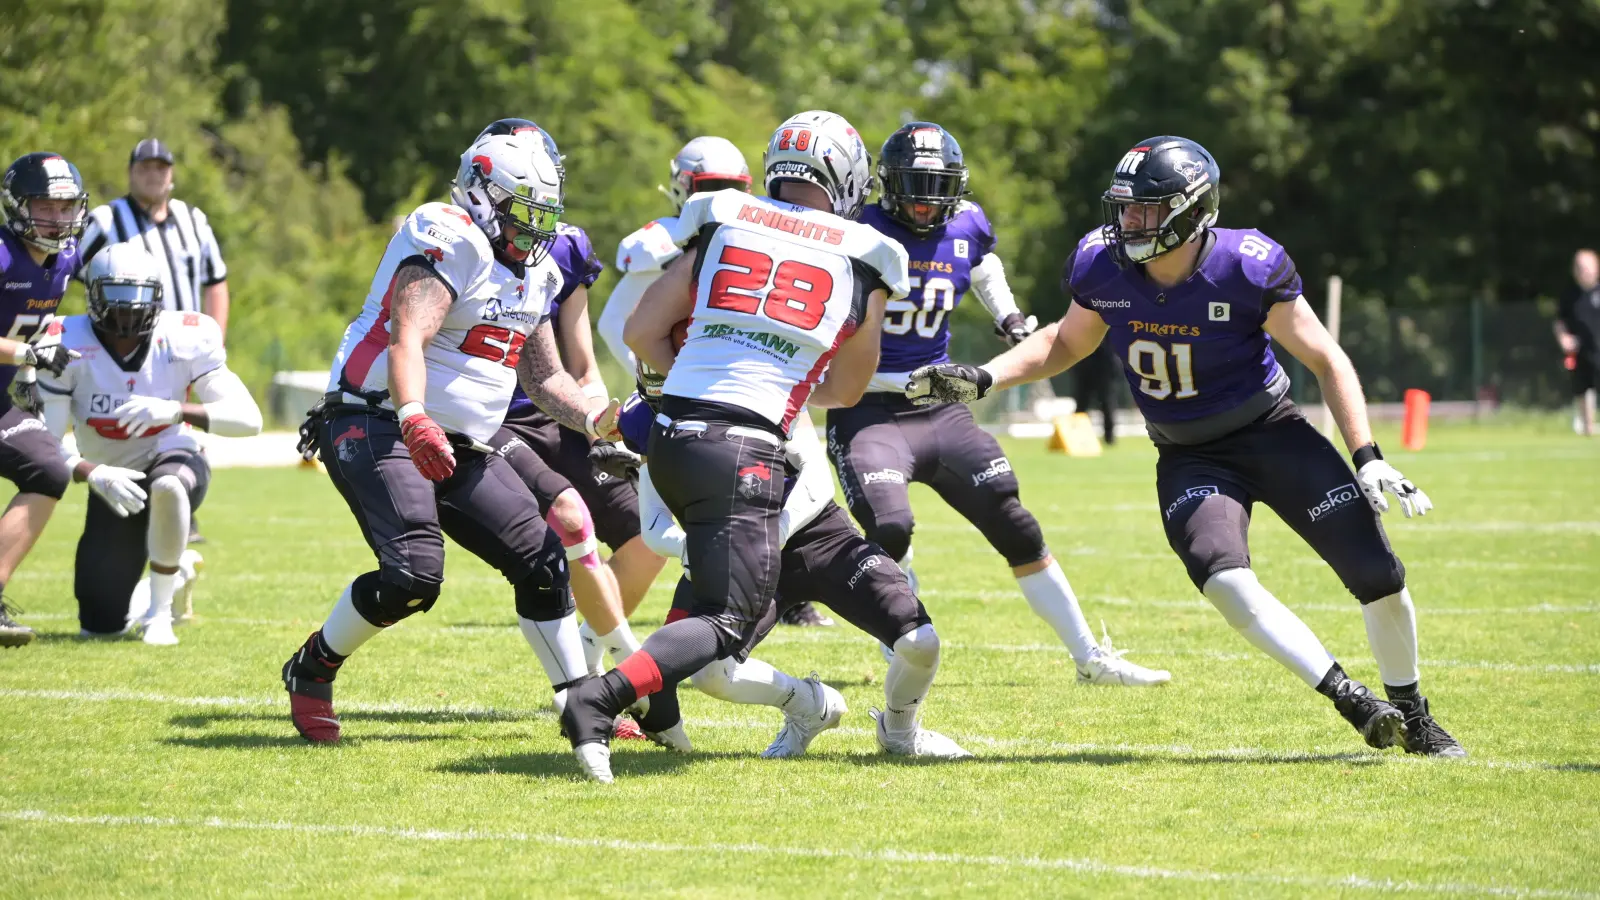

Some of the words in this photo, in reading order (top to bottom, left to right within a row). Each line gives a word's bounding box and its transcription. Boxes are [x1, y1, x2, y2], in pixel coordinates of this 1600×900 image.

[779, 129, 811, 151] 28
[775, 161, 808, 173] schutt
[736, 203, 845, 246] KNIGHTS
[909, 260, 953, 273] IRATES
[706, 245, 834, 331] 28
[1091, 299, 1131, 309] bitpanda
[883, 276, 956, 338] 50
[1214, 305, 1225, 318] B
[1127, 319, 1201, 337] PIRATES
[1128, 338, 1199, 400] 91
[1165, 485, 1220, 521] josko
[1307, 483, 1360, 522] josko
[847, 554, 882, 590] josko
